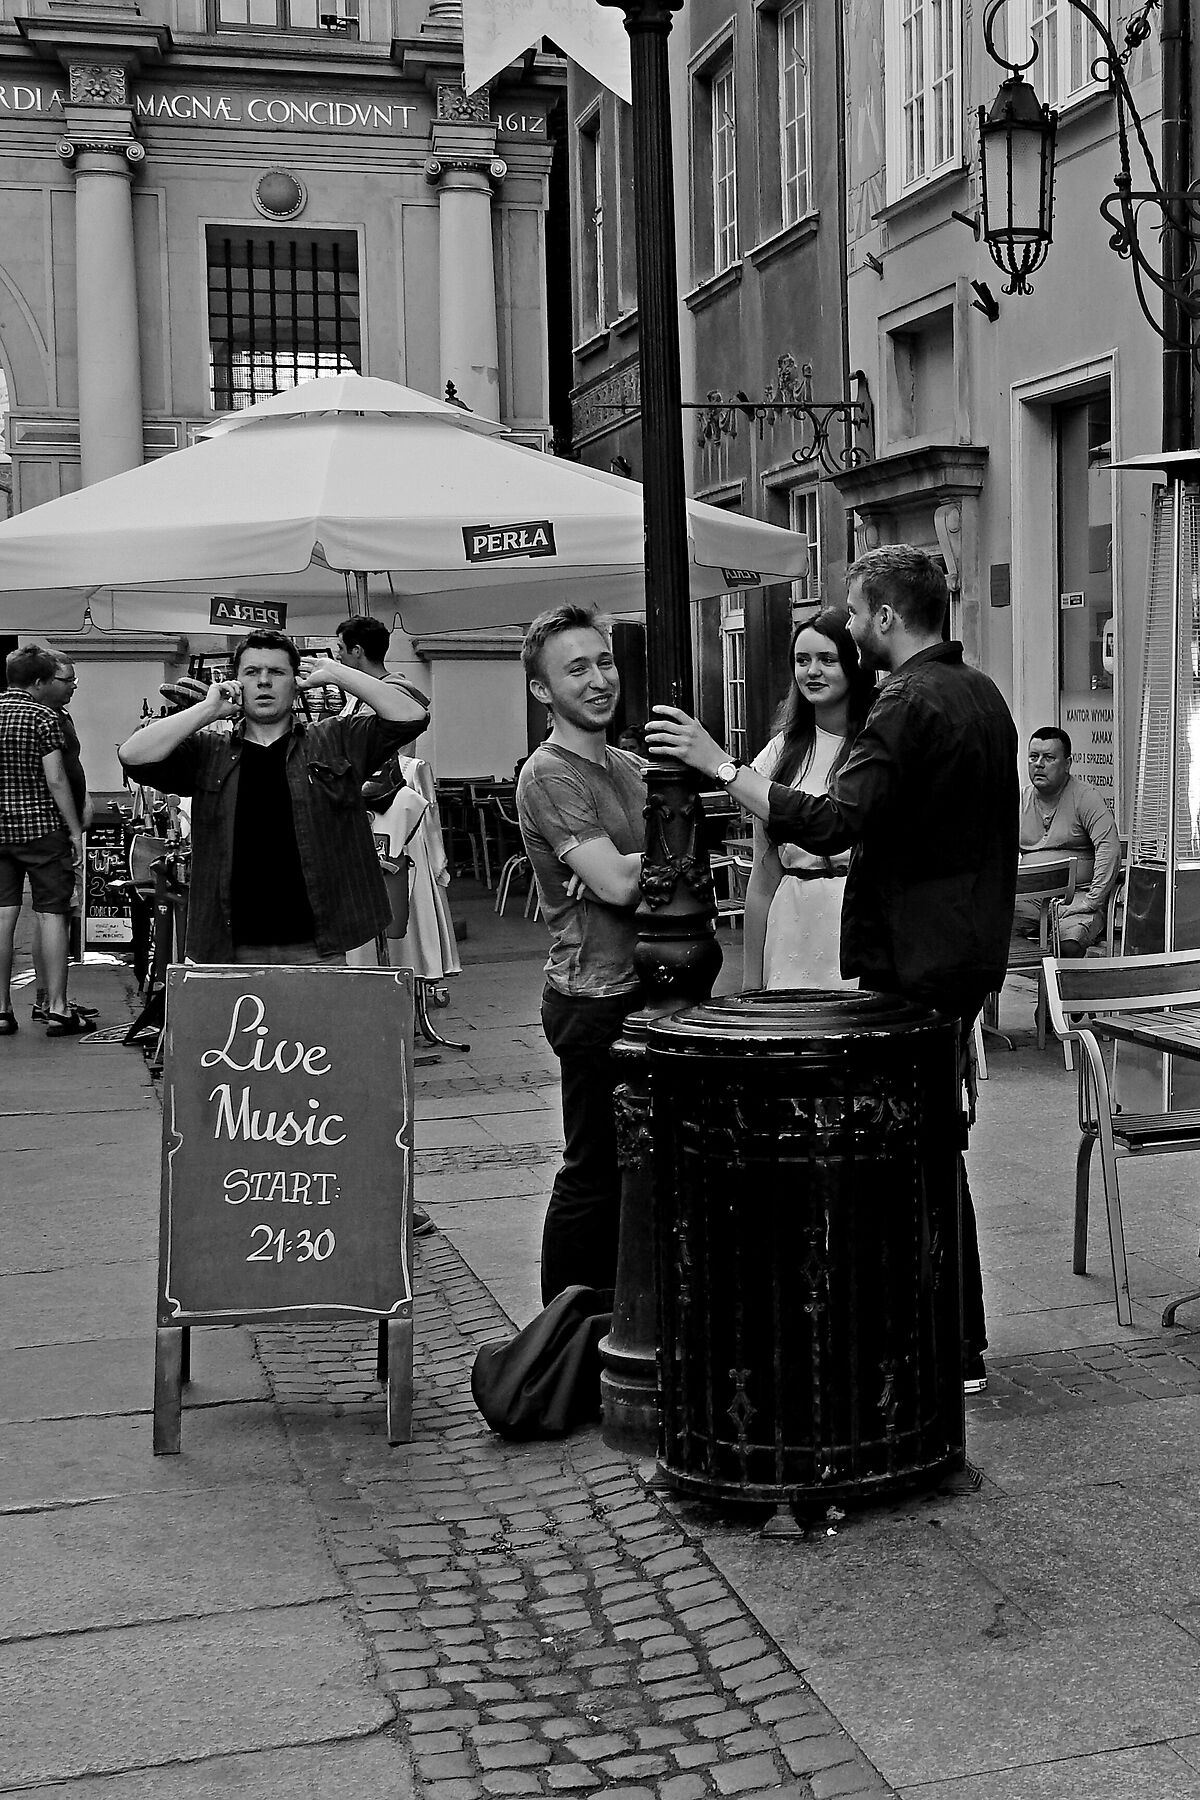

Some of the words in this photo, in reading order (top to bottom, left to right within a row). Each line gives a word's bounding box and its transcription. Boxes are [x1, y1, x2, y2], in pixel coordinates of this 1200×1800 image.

[247, 98, 417, 129] CONCIDVNT
[497, 112, 544, 133] 1612
[472, 527, 549, 556] PERŁA
[1066, 709, 1090, 722] KANTOR
[1091, 731, 1113, 744] XAMAX
[1086, 752, 1113, 765] SPRZEDAŻ
[201, 994, 332, 1075] Live
[208, 1083, 347, 1146] Music
[223, 1168, 342, 1205] START:
[246, 1224, 336, 1263] 21:30
